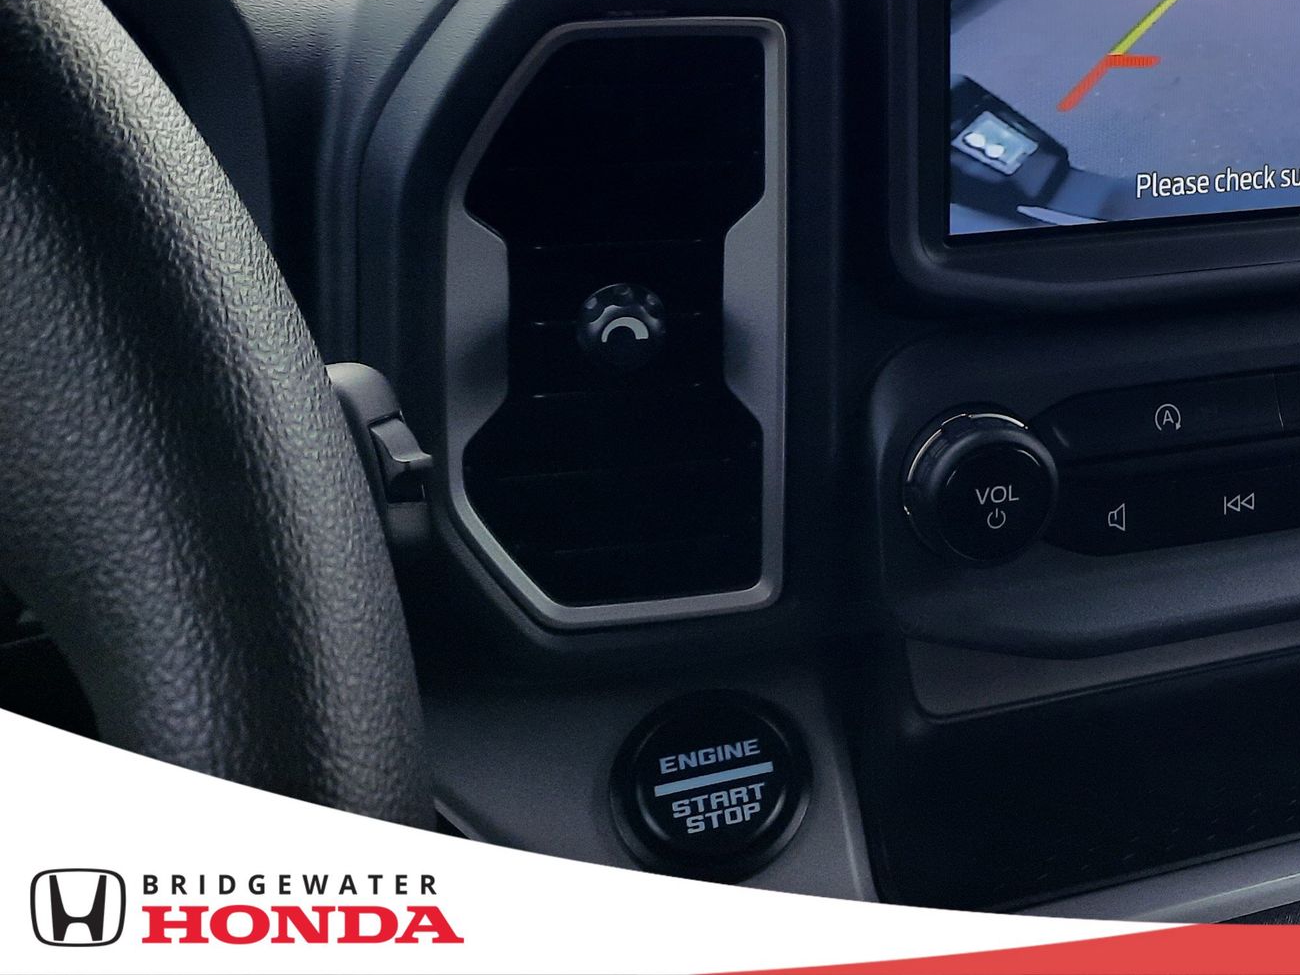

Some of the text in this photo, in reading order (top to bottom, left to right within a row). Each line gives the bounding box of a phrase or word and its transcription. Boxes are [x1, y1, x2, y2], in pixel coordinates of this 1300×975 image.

[1135, 170, 1210, 199] Please
[1213, 164, 1275, 192] check
[975, 485, 1020, 506] VOL
[659, 738, 761, 774] ENGINE
[671, 782, 765, 819] START
[686, 802, 761, 834] STOP
